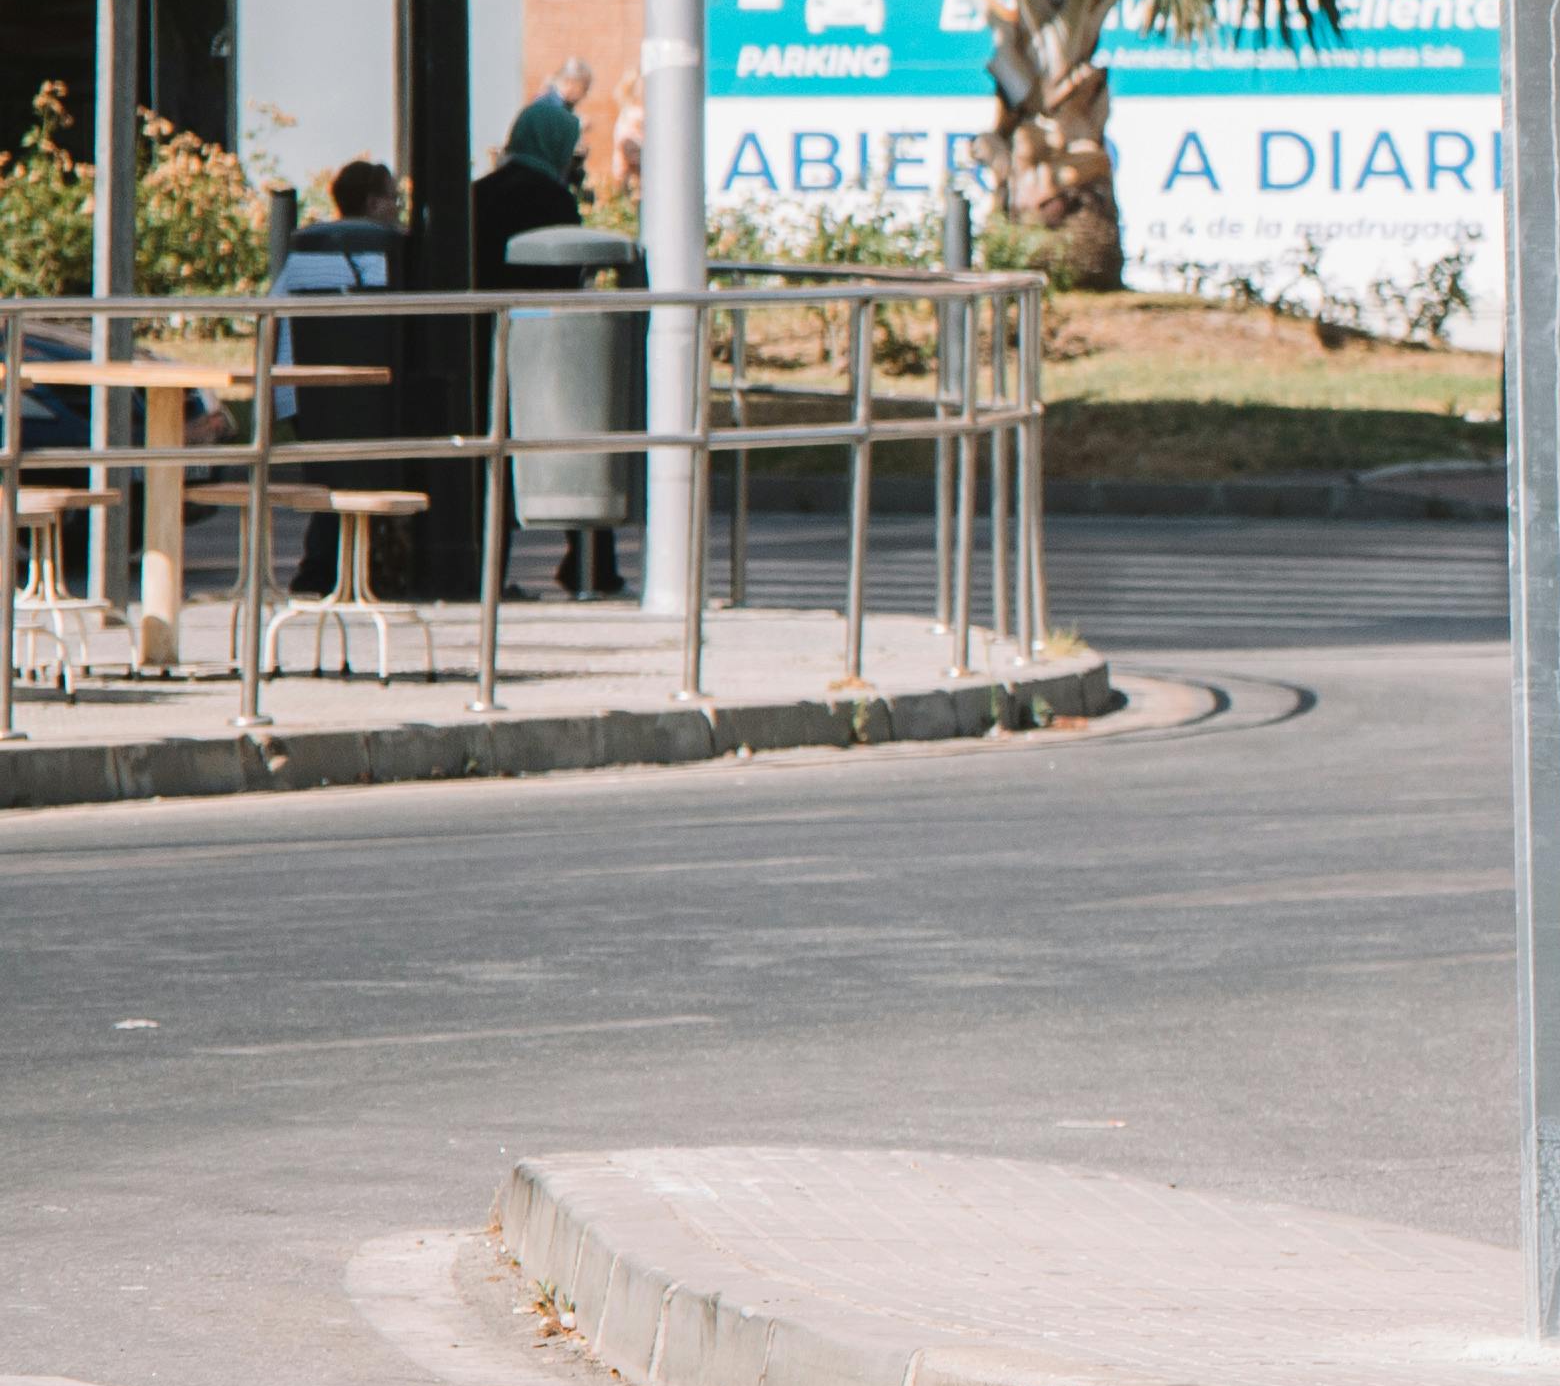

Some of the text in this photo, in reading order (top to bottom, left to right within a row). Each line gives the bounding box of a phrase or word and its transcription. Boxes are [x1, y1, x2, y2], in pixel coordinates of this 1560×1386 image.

[737, 45, 890, 79] PARKING
[722, 131, 1120, 193] ABIER
[1162, 131, 1222, 192] A
[1206, 215, 1243, 240] de
[1256, 215, 1283, 240] la
